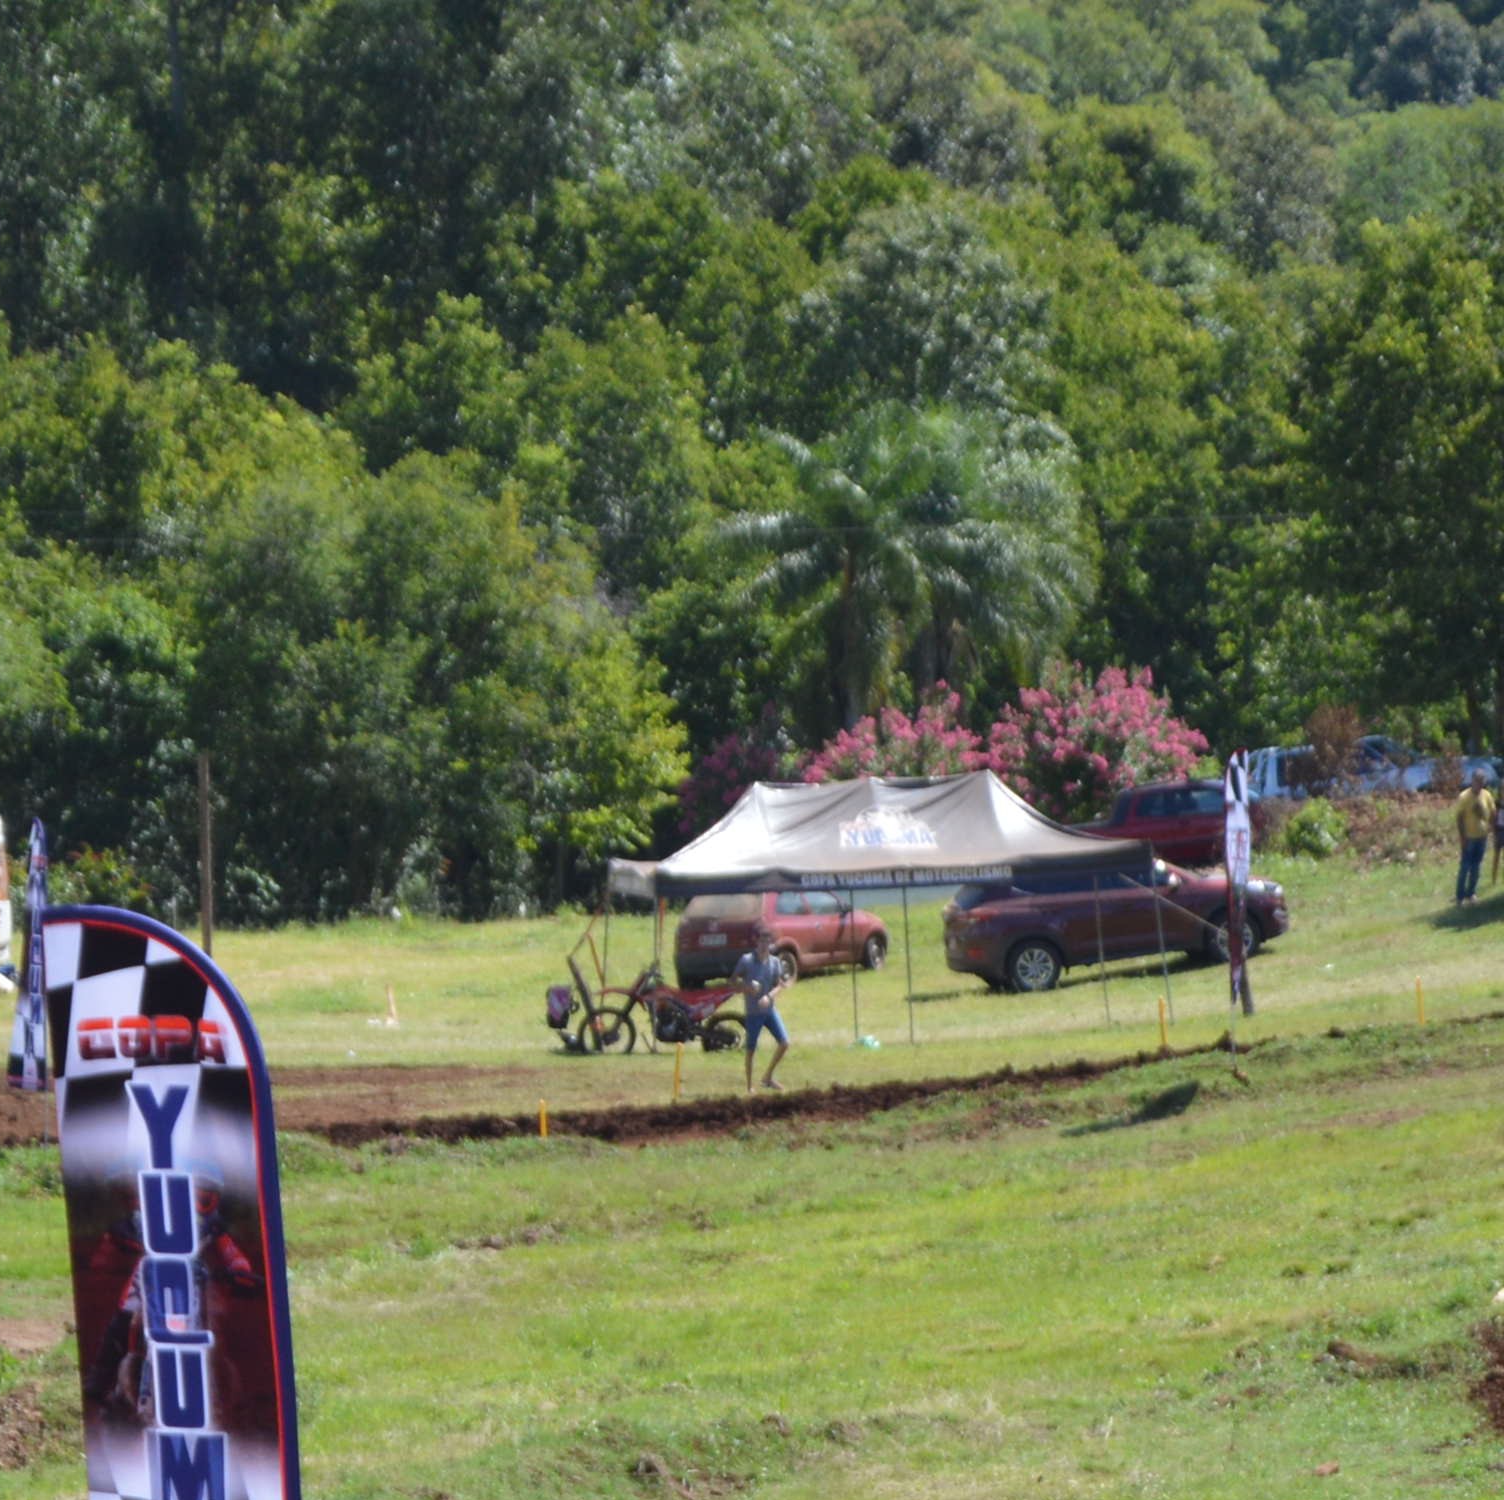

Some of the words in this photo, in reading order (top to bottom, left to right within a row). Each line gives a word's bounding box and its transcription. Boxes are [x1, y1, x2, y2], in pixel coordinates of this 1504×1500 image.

[800, 873, 837, 888] COPA
[895, 869, 911, 884] DE
[913, 864, 1014, 883] MOTOCICLISMO
[76, 1014, 228, 1064] COPA
